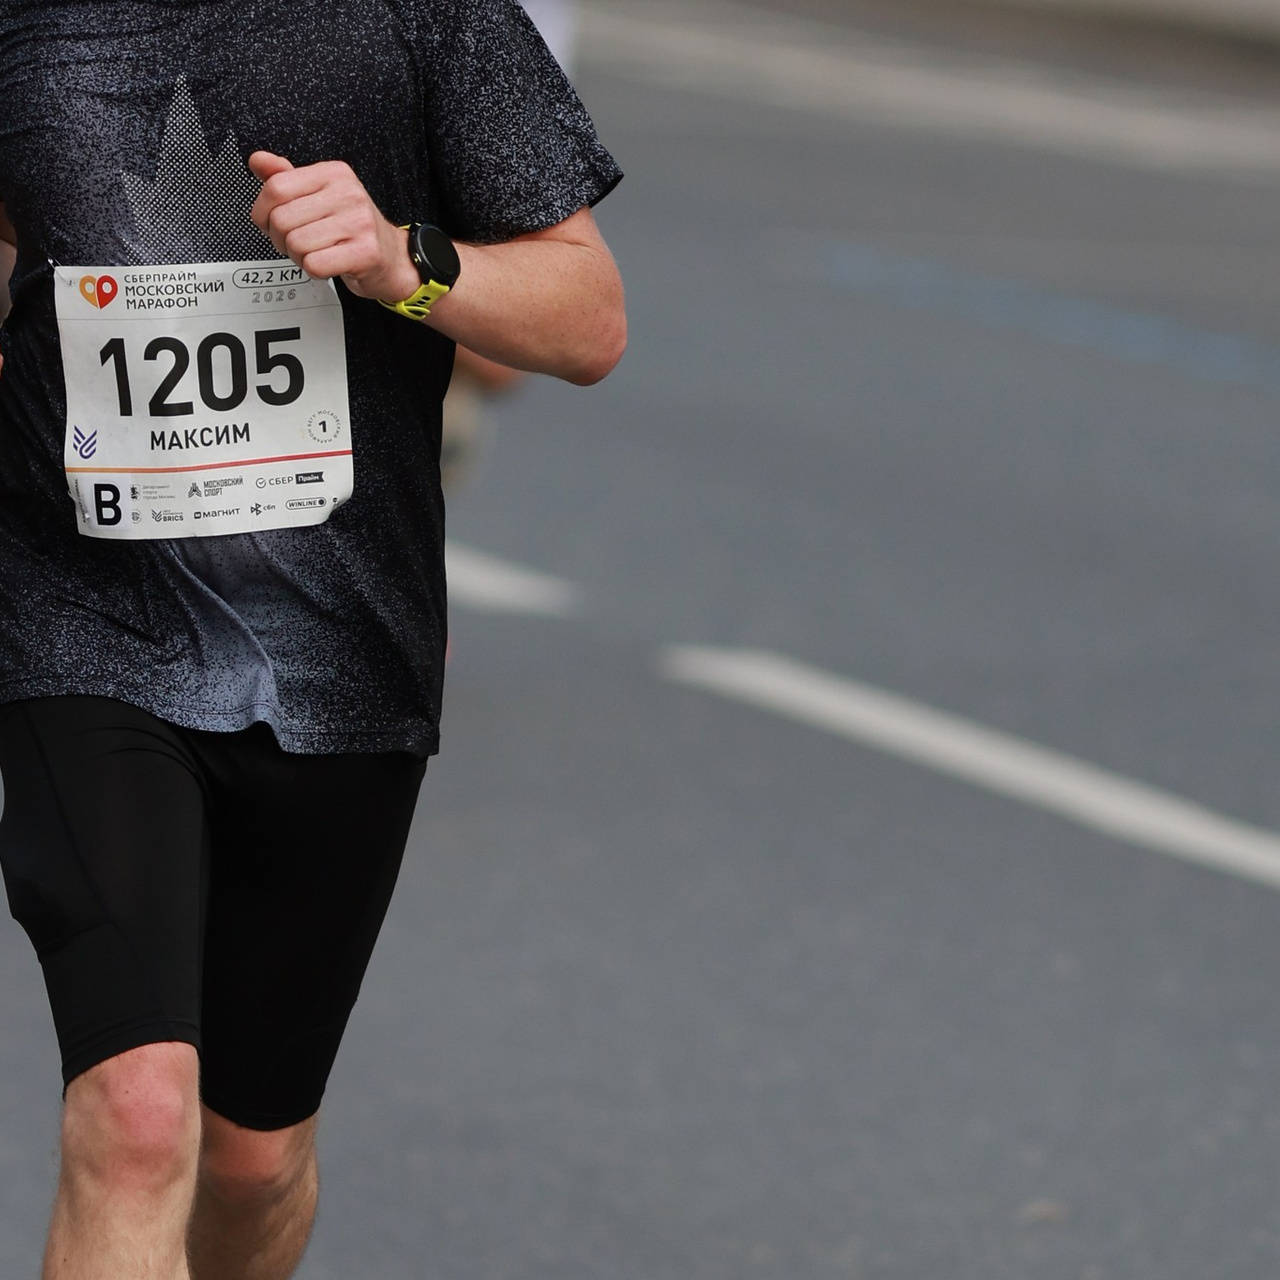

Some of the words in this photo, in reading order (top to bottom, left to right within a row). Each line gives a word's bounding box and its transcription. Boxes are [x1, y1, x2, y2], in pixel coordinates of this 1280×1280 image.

[123, 271, 197, 284] СБЕРПРАЙМ
[241, 270, 274, 285] 42,2
[280, 268, 303, 282] КМ
[125, 280, 225, 297] МОСКОВСКИЙ
[126, 296, 198, 310] МАРАФОН
[251, 289, 297, 303] 2026
[99, 326, 305, 417] 1205
[318, 420, 327, 433] 1
[150, 422, 251, 451] МАКСИМ
[203, 475, 244, 489] МОСКОВСКИЙ
[268, 476, 294, 486] СБЕР
[204, 487, 223, 497] СПОРТ
[93, 483, 122, 526] B
[288, 500, 318, 508] WINLINE
